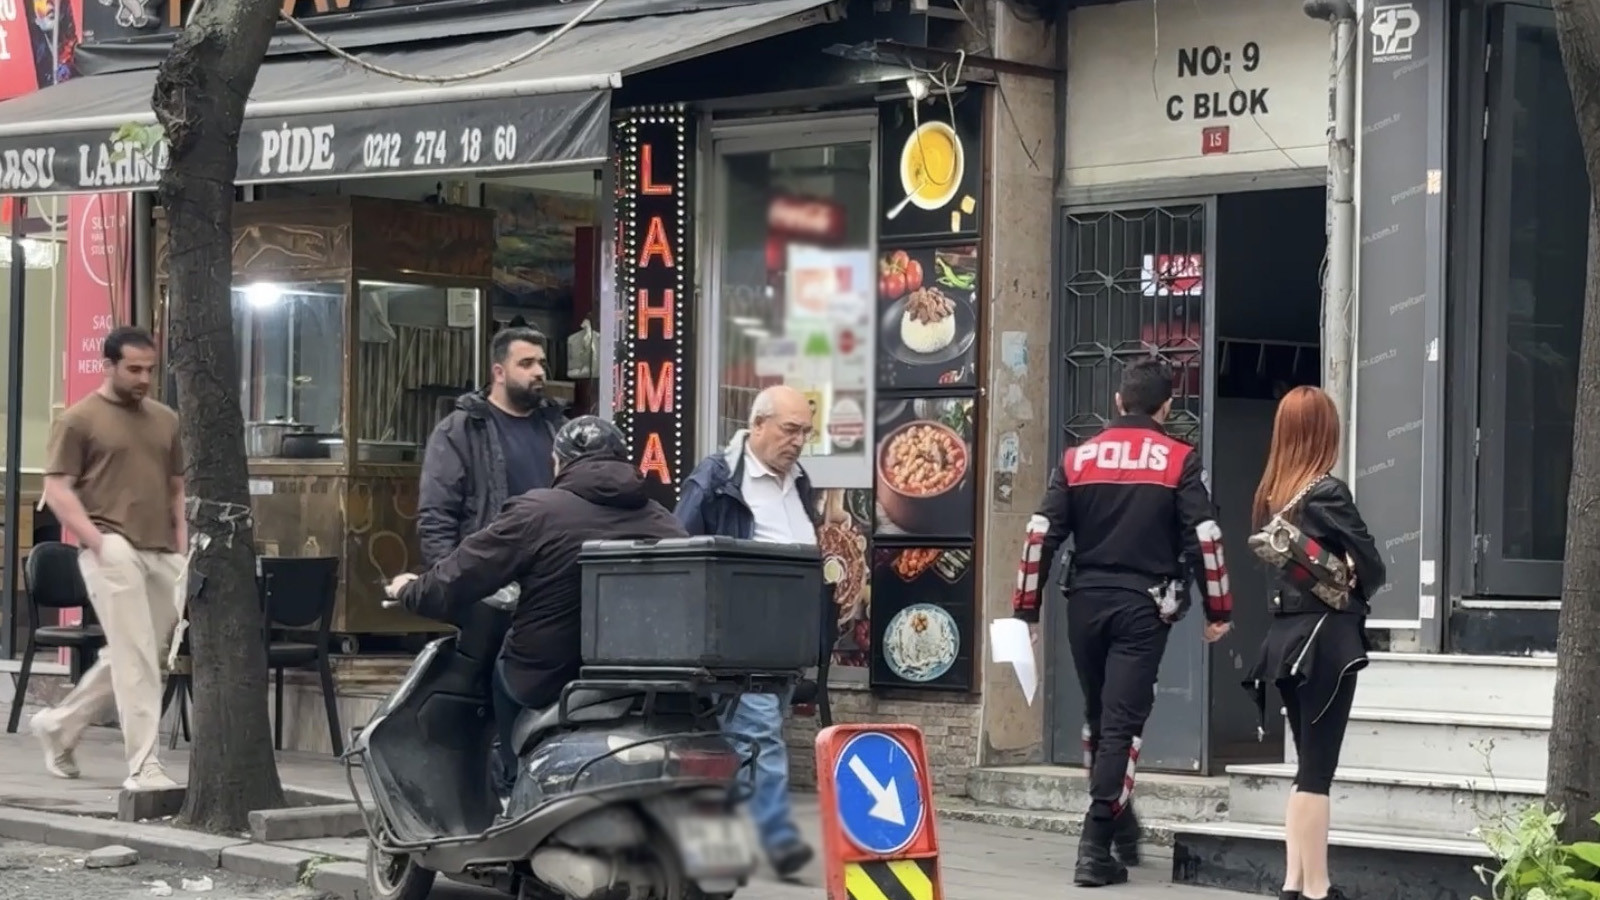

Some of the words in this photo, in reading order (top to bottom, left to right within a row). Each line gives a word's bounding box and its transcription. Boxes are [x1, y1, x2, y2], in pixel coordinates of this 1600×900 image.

[1178, 46, 1231, 77] NO:
[1243, 41, 1260, 72] 9
[1166, 95, 1184, 121] C
[1194, 88, 1269, 119] BLOK
[0, 147, 55, 189] RSU
[260, 122, 336, 174] PİDE
[363, 132, 402, 168] 0212
[413, 130, 446, 166] 274
[460, 127, 482, 164] 18
[494, 124, 517, 161] 60
[1209, 133, 1222, 147] 15
[1073, 437, 1170, 472] POLİS
